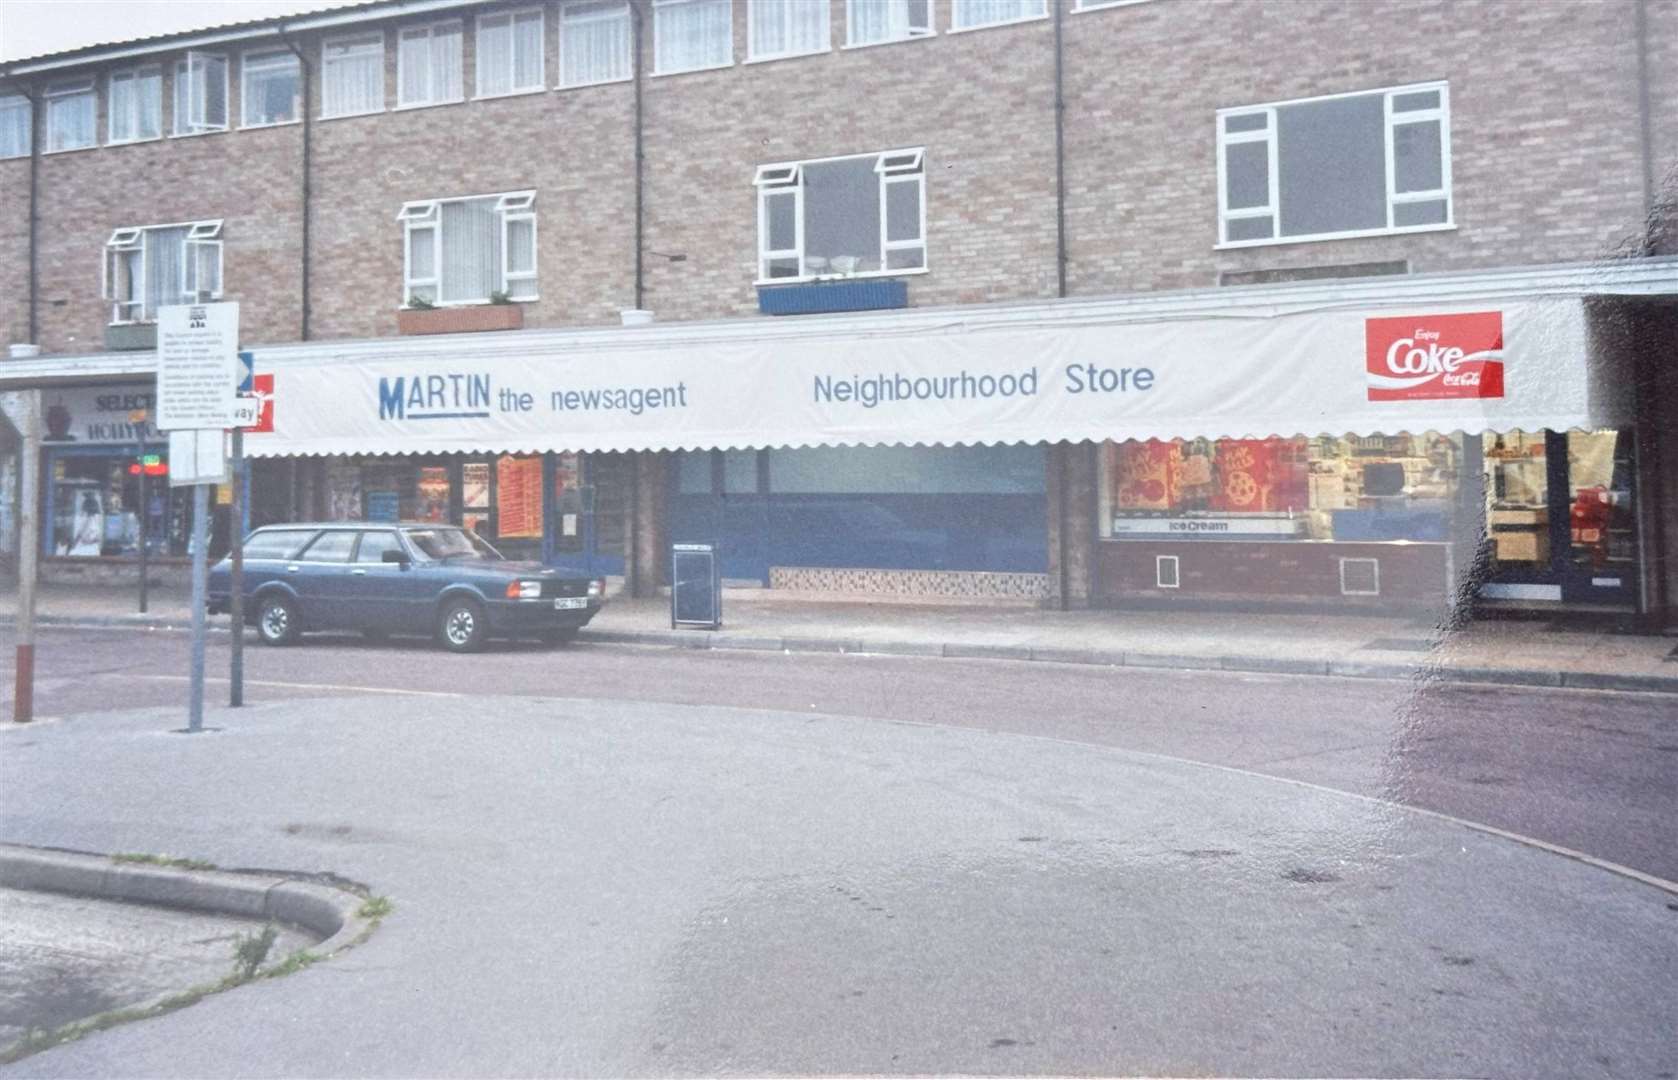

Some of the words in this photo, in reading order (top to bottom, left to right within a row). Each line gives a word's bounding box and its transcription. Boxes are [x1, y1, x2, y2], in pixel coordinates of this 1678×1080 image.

[1415, 329, 1440, 340] Enjoy
[1387, 338, 1465, 374] Coke
[379, 374, 490, 420] MARTIN
[499, 387, 534, 412] the
[551, 381, 687, 416] newsagent
[814, 367, 1037, 408] Neighbourhood
[1065, 363, 1155, 394] Store
